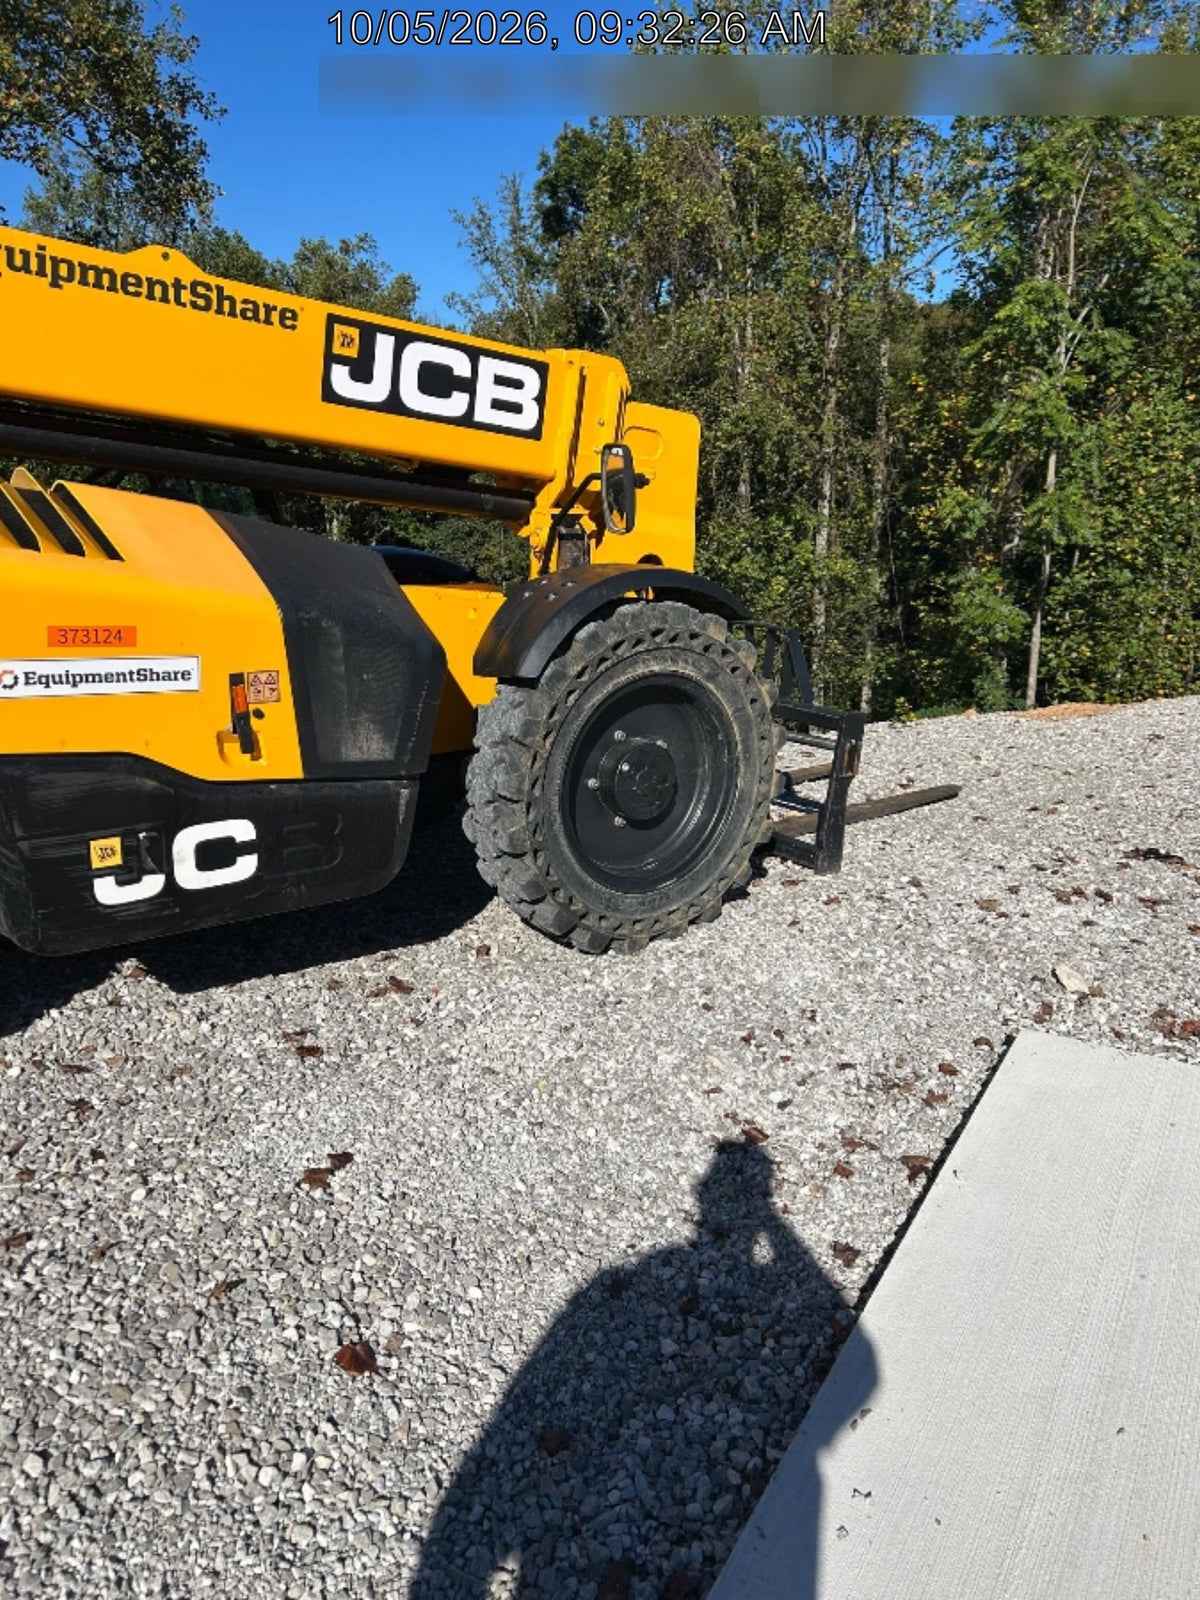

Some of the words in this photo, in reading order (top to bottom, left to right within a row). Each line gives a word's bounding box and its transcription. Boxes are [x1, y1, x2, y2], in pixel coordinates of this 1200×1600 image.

[0, 243, 299, 331] uipmentShare
[330, 331, 541, 431] JCB
[57, 627, 123, 645] 373124
[23, 668, 192, 688] EquipmentShare
